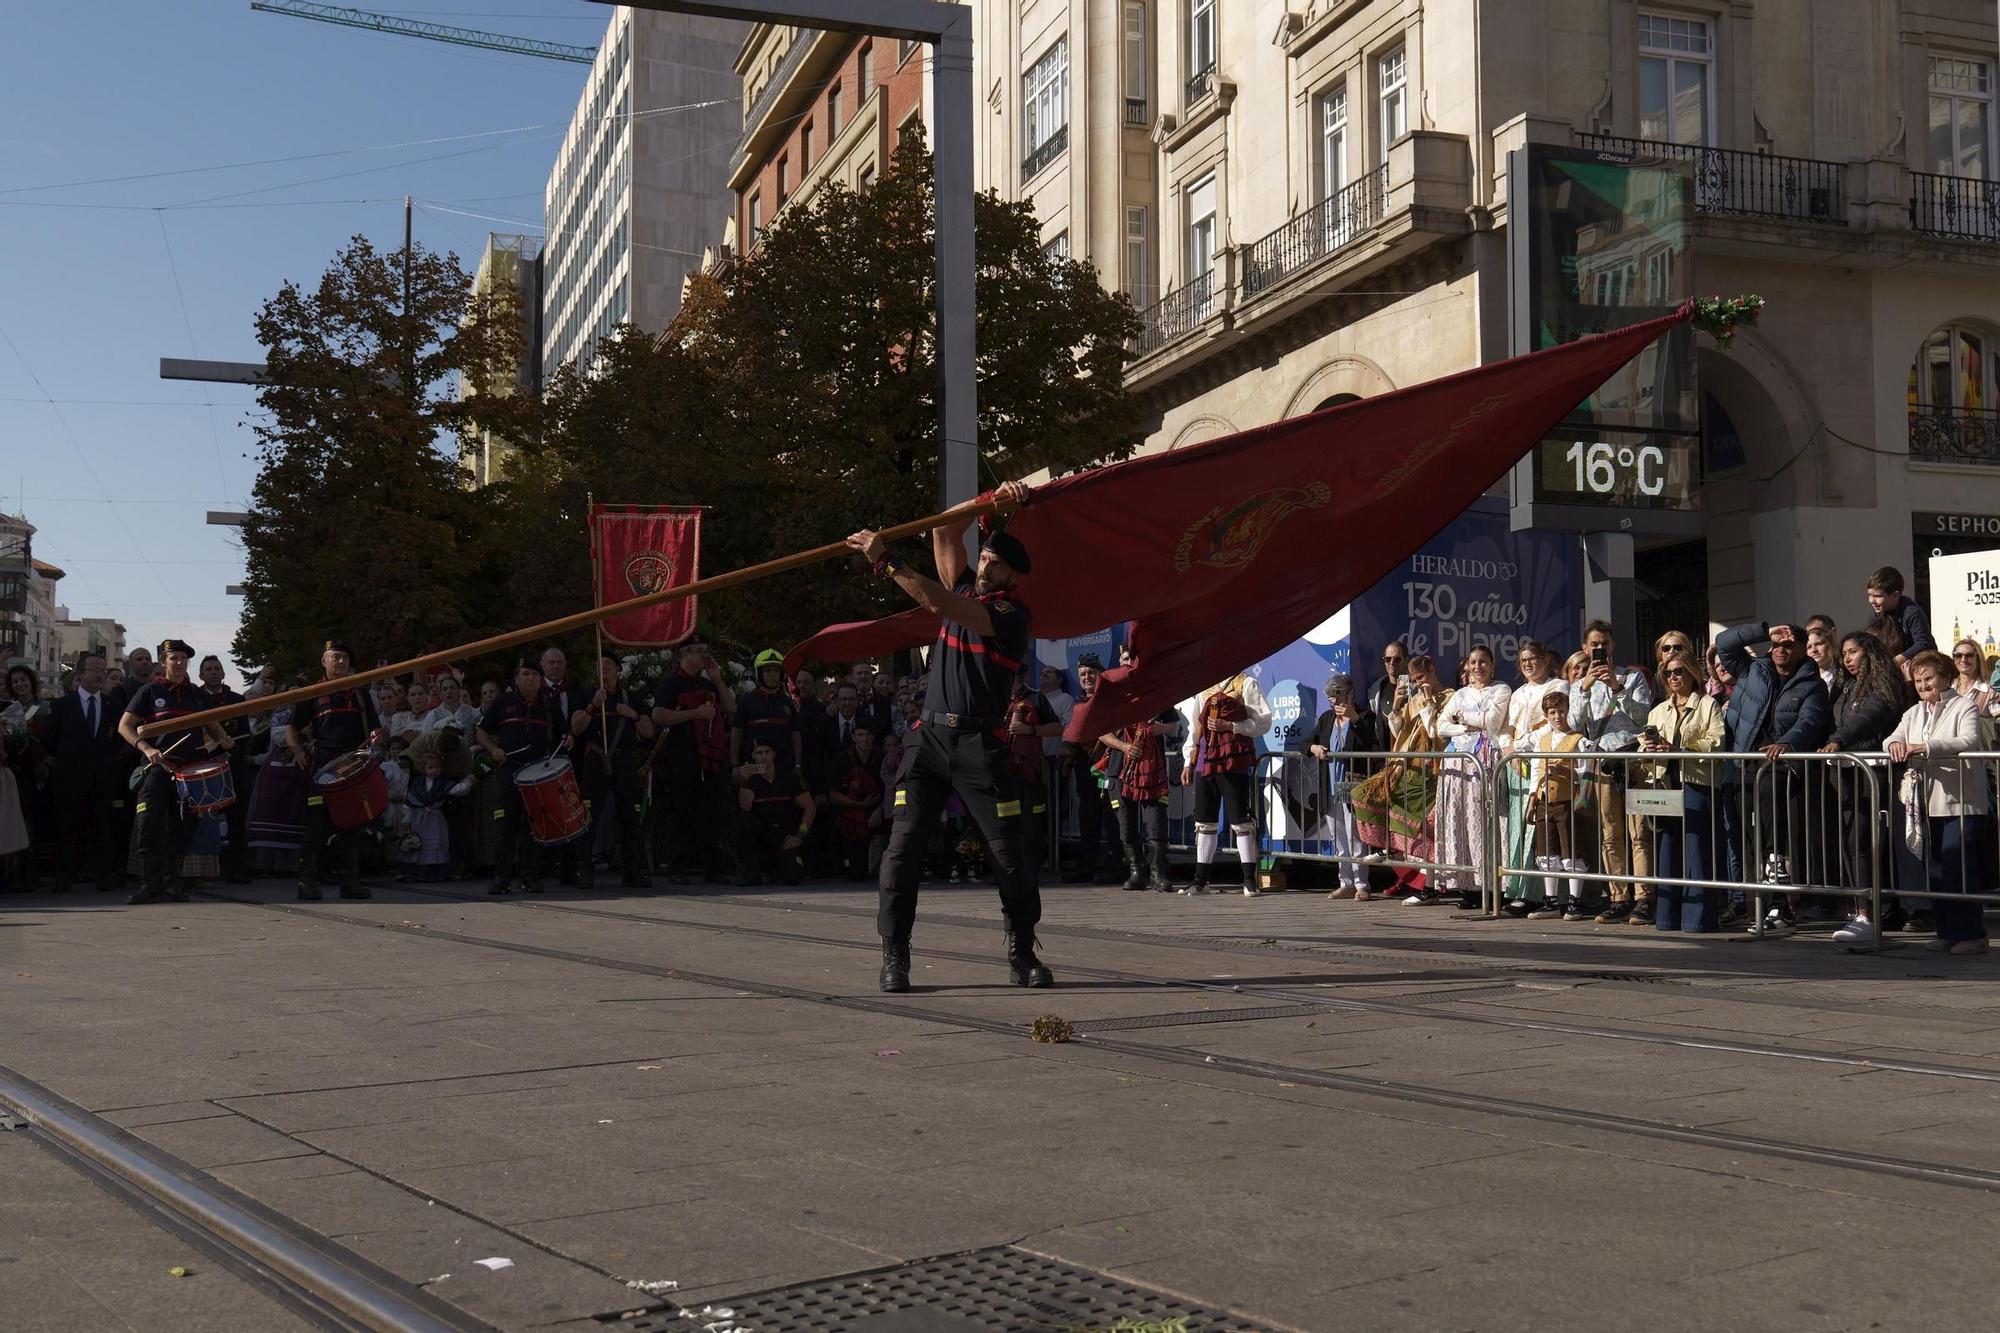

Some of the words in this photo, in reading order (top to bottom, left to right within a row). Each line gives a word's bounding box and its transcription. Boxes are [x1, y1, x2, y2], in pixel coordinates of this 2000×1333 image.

[1596, 153, 1630, 163] JCDecaux
[1566, 441, 1664, 496] 16°C
[1936, 515, 2000, 534] SEPHO
[1411, 553, 1497, 580] HERALDO
[1967, 569, 1999, 591] Pila
[1402, 581, 1457, 620] 130
[1466, 592, 1528, 625] años
[1974, 592, 2000, 606] 2025
[1068, 633, 1111, 648] ANIVERSARIO
[1398, 619, 1429, 656] de
[1273, 695, 1302, 708] LIBRO
[1282, 707, 1307, 719] JOTA
[1274, 725, 1302, 740] 9,95€
